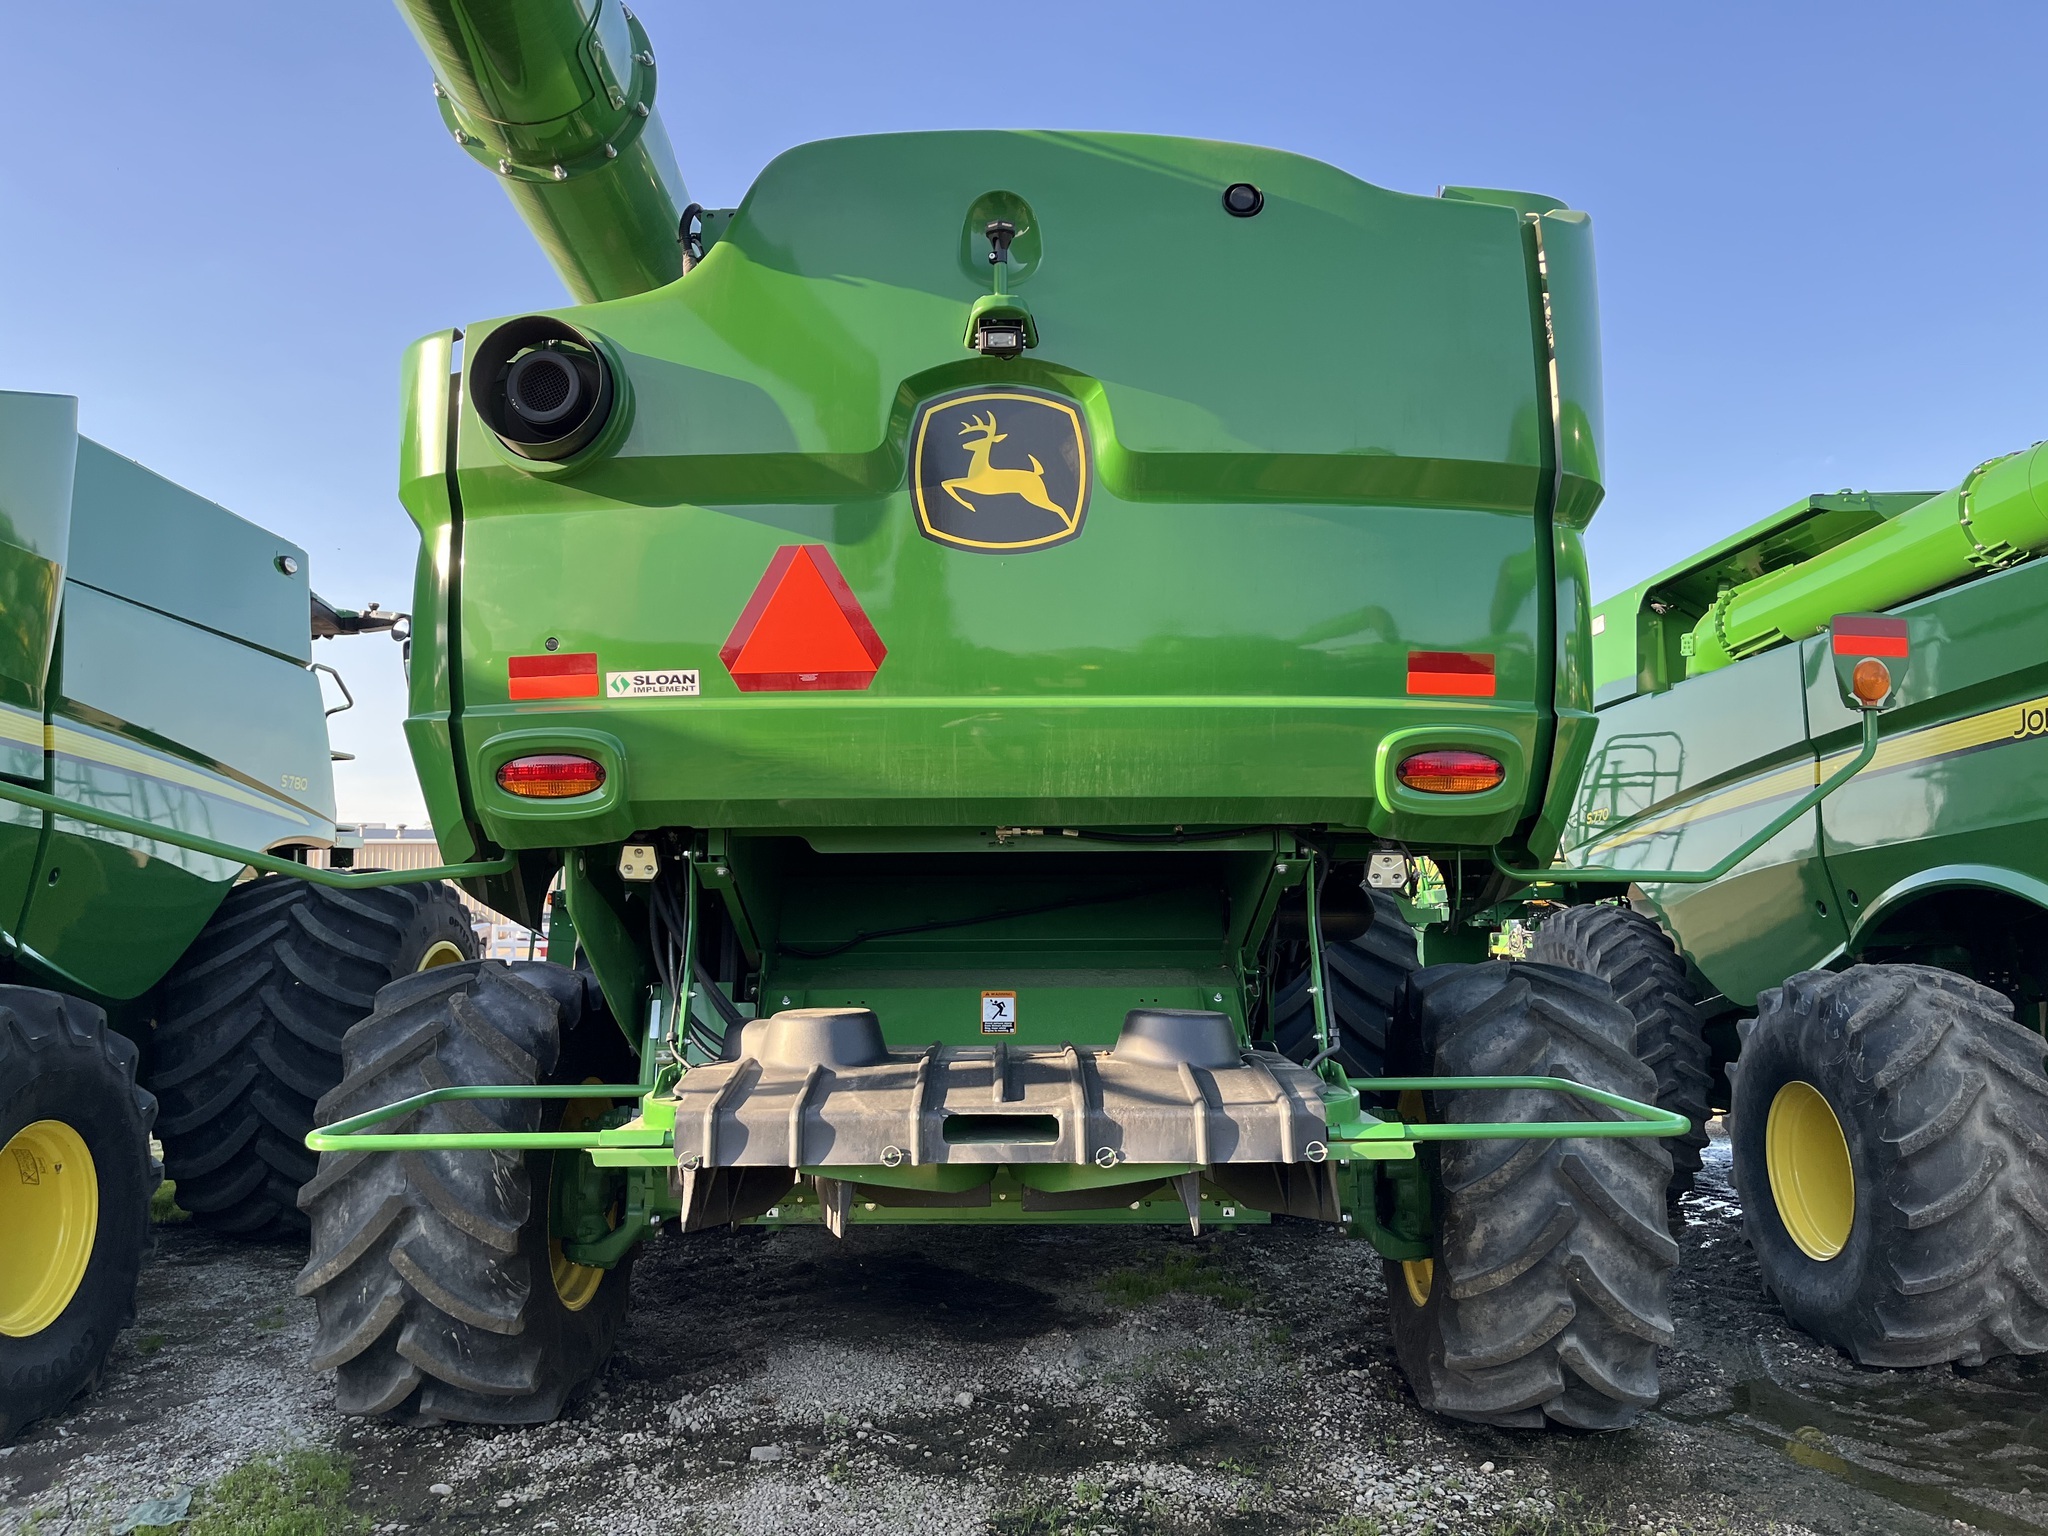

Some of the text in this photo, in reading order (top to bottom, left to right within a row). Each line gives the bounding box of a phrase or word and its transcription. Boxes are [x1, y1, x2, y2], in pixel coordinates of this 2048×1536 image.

[633, 674, 695, 685] SLOAN
[633, 685, 696, 693] IMPLEMENT
[2014, 708, 2048, 735] JO
[1586, 807, 1609, 825] S770
